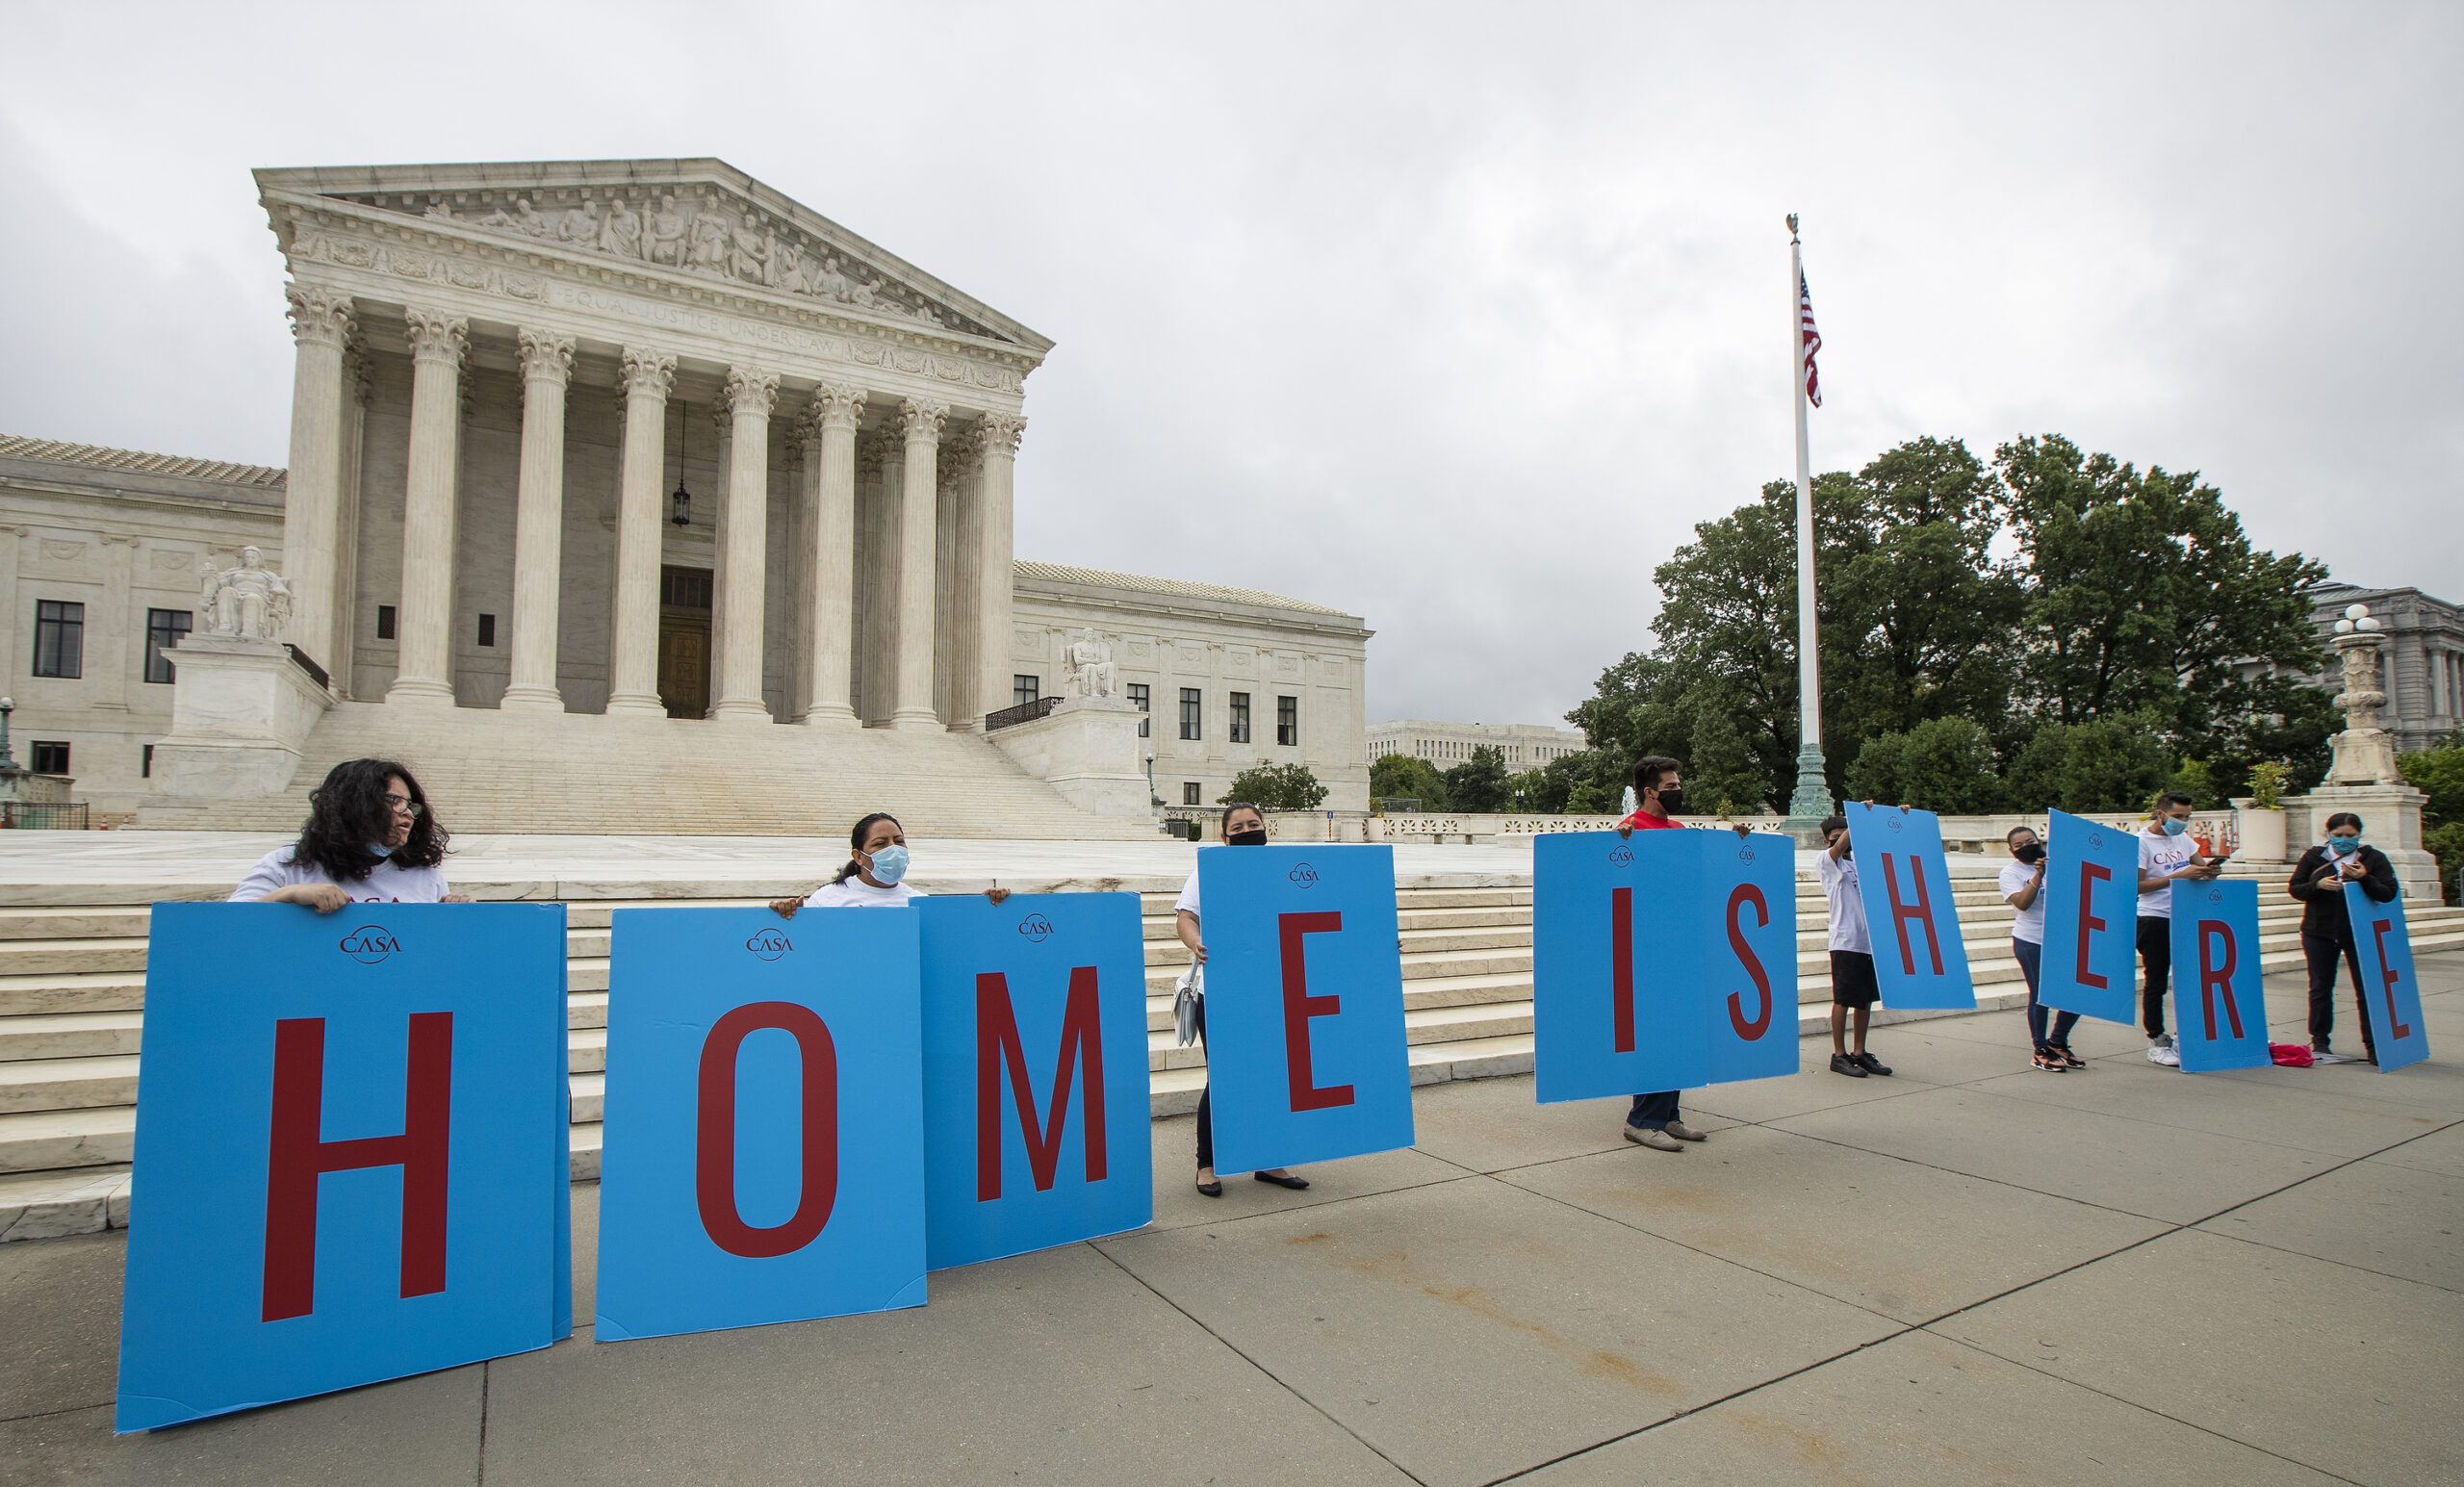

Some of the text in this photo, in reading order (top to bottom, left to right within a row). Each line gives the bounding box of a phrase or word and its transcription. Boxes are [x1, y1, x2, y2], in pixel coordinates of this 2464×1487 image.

[564, 288, 834, 353] EQUAL JUSTICE UNDER LAW
[1289, 869, 1320, 882] CASA
[1608, 851, 1635, 862] CASA
[1882, 853, 1944, 975] H
[2153, 851, 2183, 865] CASA
[339, 936, 402, 954] CASA
[746, 936, 794, 952] CASA
[1018, 921, 1055, 936] CASA
[1612, 887, 1635, 1053] I
[1727, 884, 1772, 1041] S
[2076, 861, 2111, 989] E
[2198, 920, 2246, 1040] R
[2372, 918, 2410, 1040] E
[1278, 911, 1355, 1113] E
[696, 1001, 838, 1258] O
[976, 966, 1107, 1202] M
[261, 1012, 453, 1322] H
